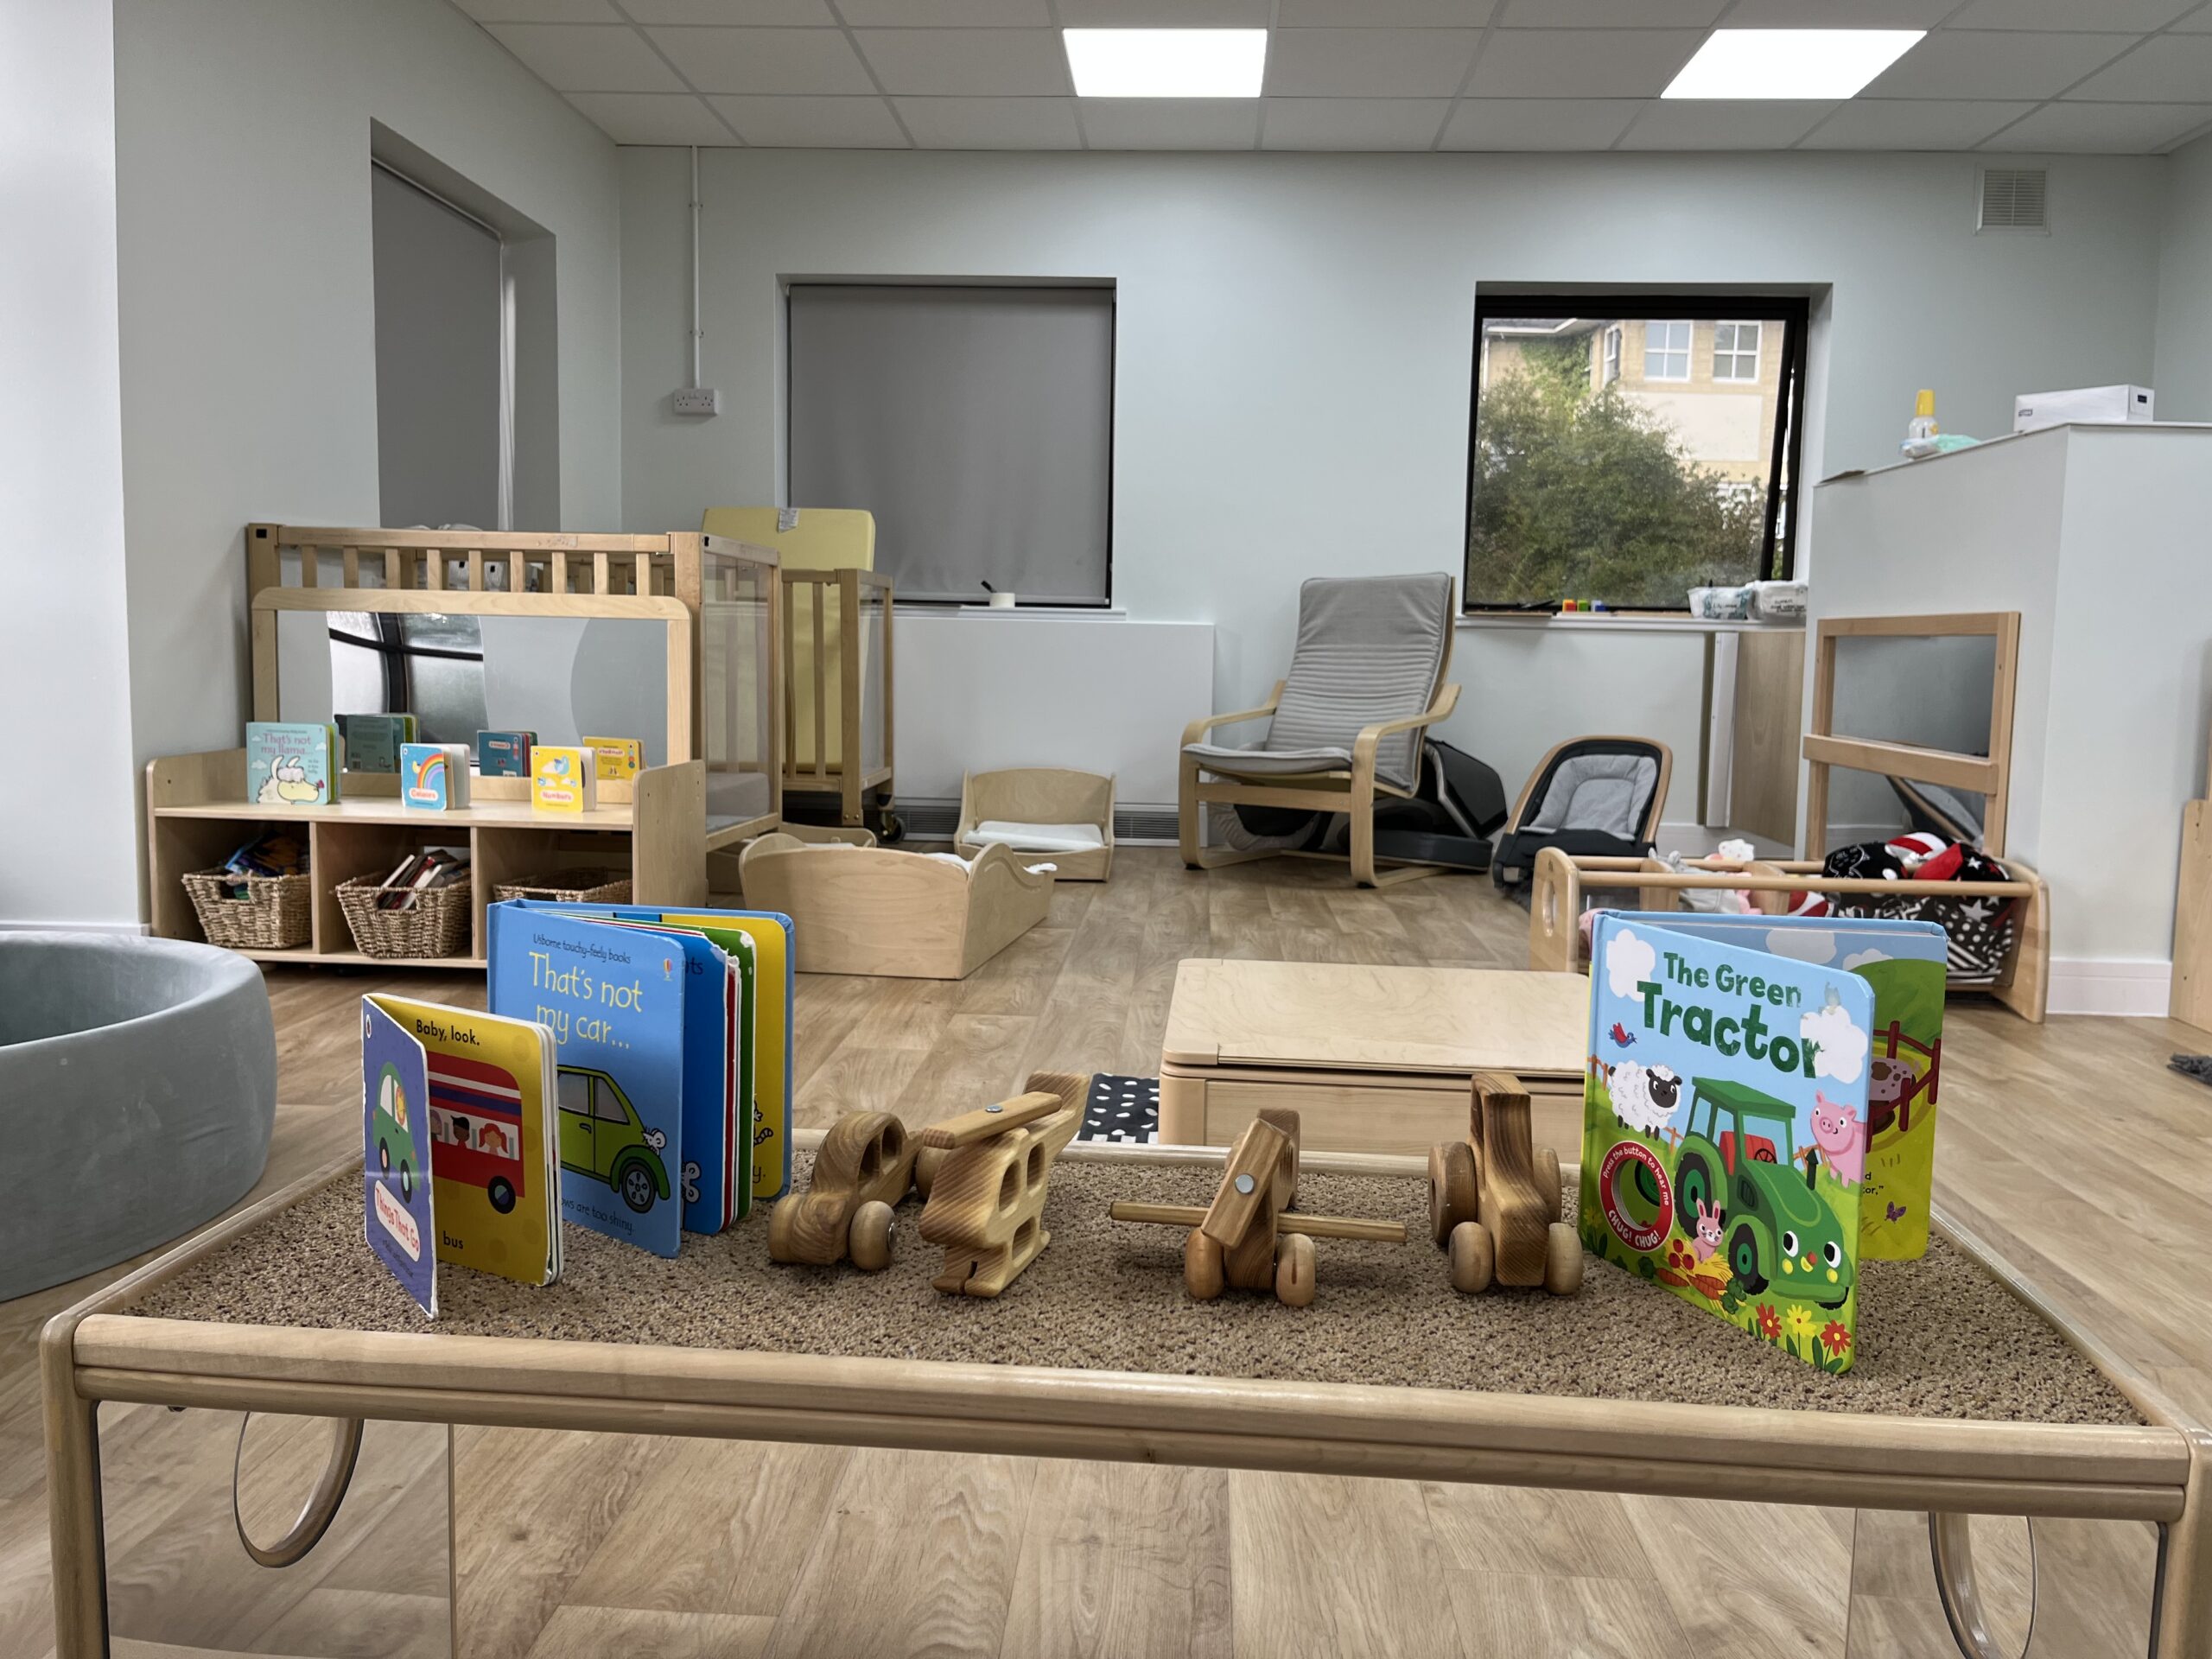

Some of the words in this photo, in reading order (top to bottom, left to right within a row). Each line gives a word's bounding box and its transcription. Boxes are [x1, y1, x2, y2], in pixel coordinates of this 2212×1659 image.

[262, 747, 276, 756] my
[263, 733, 291, 744] That's
[295, 736, 311, 745] not
[542, 791, 571, 801] Numbers
[533, 933, 561, 950] Usborne
[563, 939, 607, 963] touchy-feely
[608, 948, 631, 964] books
[529, 950, 593, 1000] That's
[601, 979, 643, 1013] not
[1663, 951, 1709, 988] The
[1715, 963, 1802, 1008] Green
[416, 1019, 447, 1042] Baby,
[451, 1025, 480, 1046] look.
[536, 1004, 569, 1045] my
[1637, 980, 1825, 1079] Tractor
[1612, 1148, 1624, 1159] the
[1623, 1146, 1647, 1161] button
[1647, 1157, 1656, 1169] to
[1654, 1167, 1667, 1190] hear
[1662, 1192, 1669, 1206] me
[375, 1187, 395, 1226] Things
[393, 1208, 410, 1242] That
[410, 1227, 419, 1253] Go
[576, 1204, 589, 1216] are
[592, 1206, 607, 1223] too
[1608, 1210, 1632, 1243] CHUG!
[1635, 1230, 1662, 1248] CHUG!
[442, 1230, 464, 1250] bus
